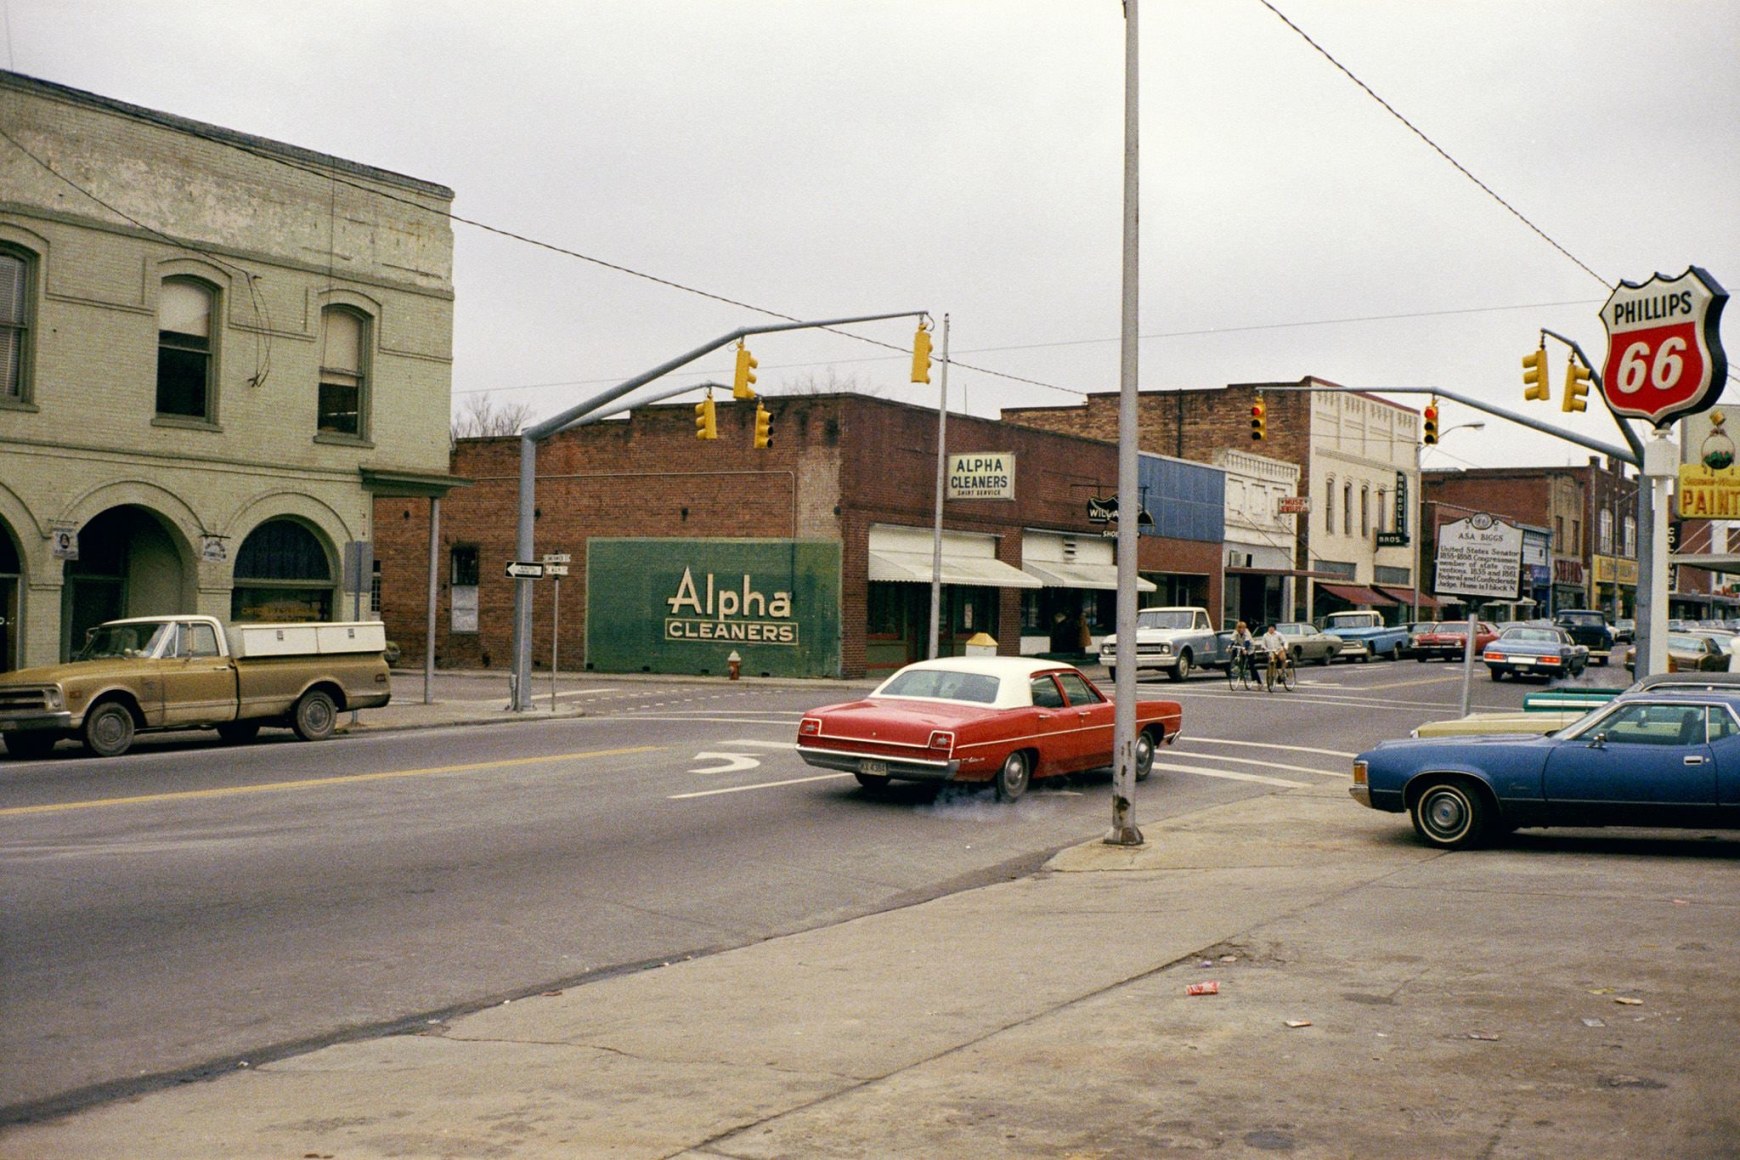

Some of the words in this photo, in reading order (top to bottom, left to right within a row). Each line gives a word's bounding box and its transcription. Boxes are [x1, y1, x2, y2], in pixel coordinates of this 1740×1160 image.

[1614, 290, 1692, 325] PHILLIPS
[1616, 336, 1687, 394] 66
[956, 458, 1003, 472] ALPHA
[951, 475, 1008, 489] CLEANERS
[1458, 532, 1475, 541] ASA
[1476, 576, 1516, 584] Confederate
[667, 566, 791, 621] Alpha
[669, 621, 794, 641] CLEANERS
